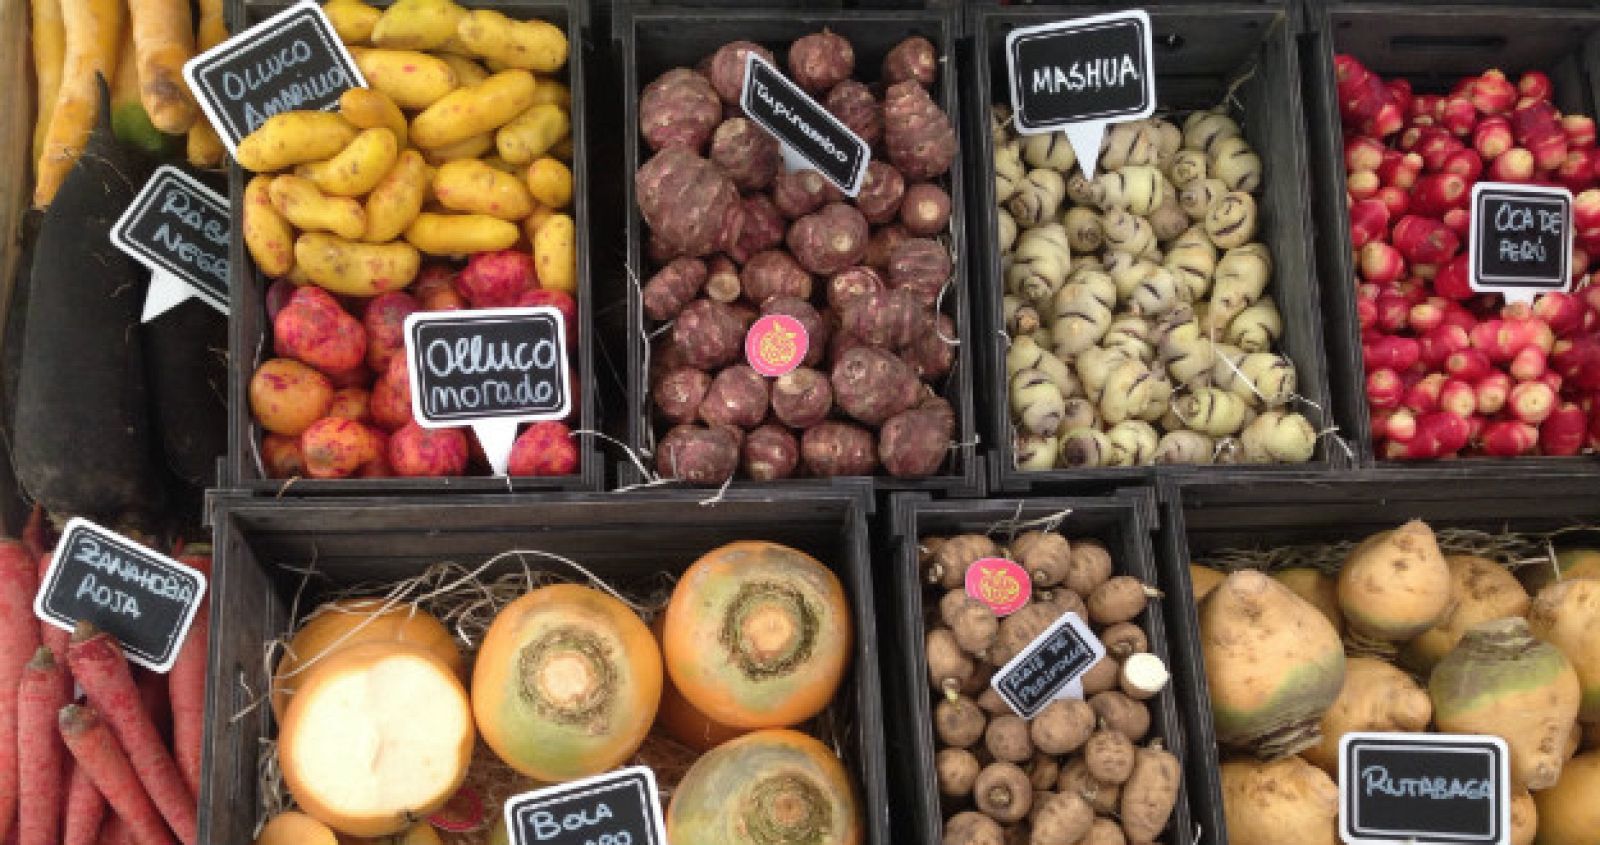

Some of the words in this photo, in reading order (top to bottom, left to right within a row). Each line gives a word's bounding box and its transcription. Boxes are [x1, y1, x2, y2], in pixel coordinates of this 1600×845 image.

[1032, 53, 1138, 95] MASHUA
[1494, 200, 1534, 232] OCA
[1536, 208, 1562, 236] DE
[431, 373, 553, 413] morado
[529, 802, 614, 841] BOLA
